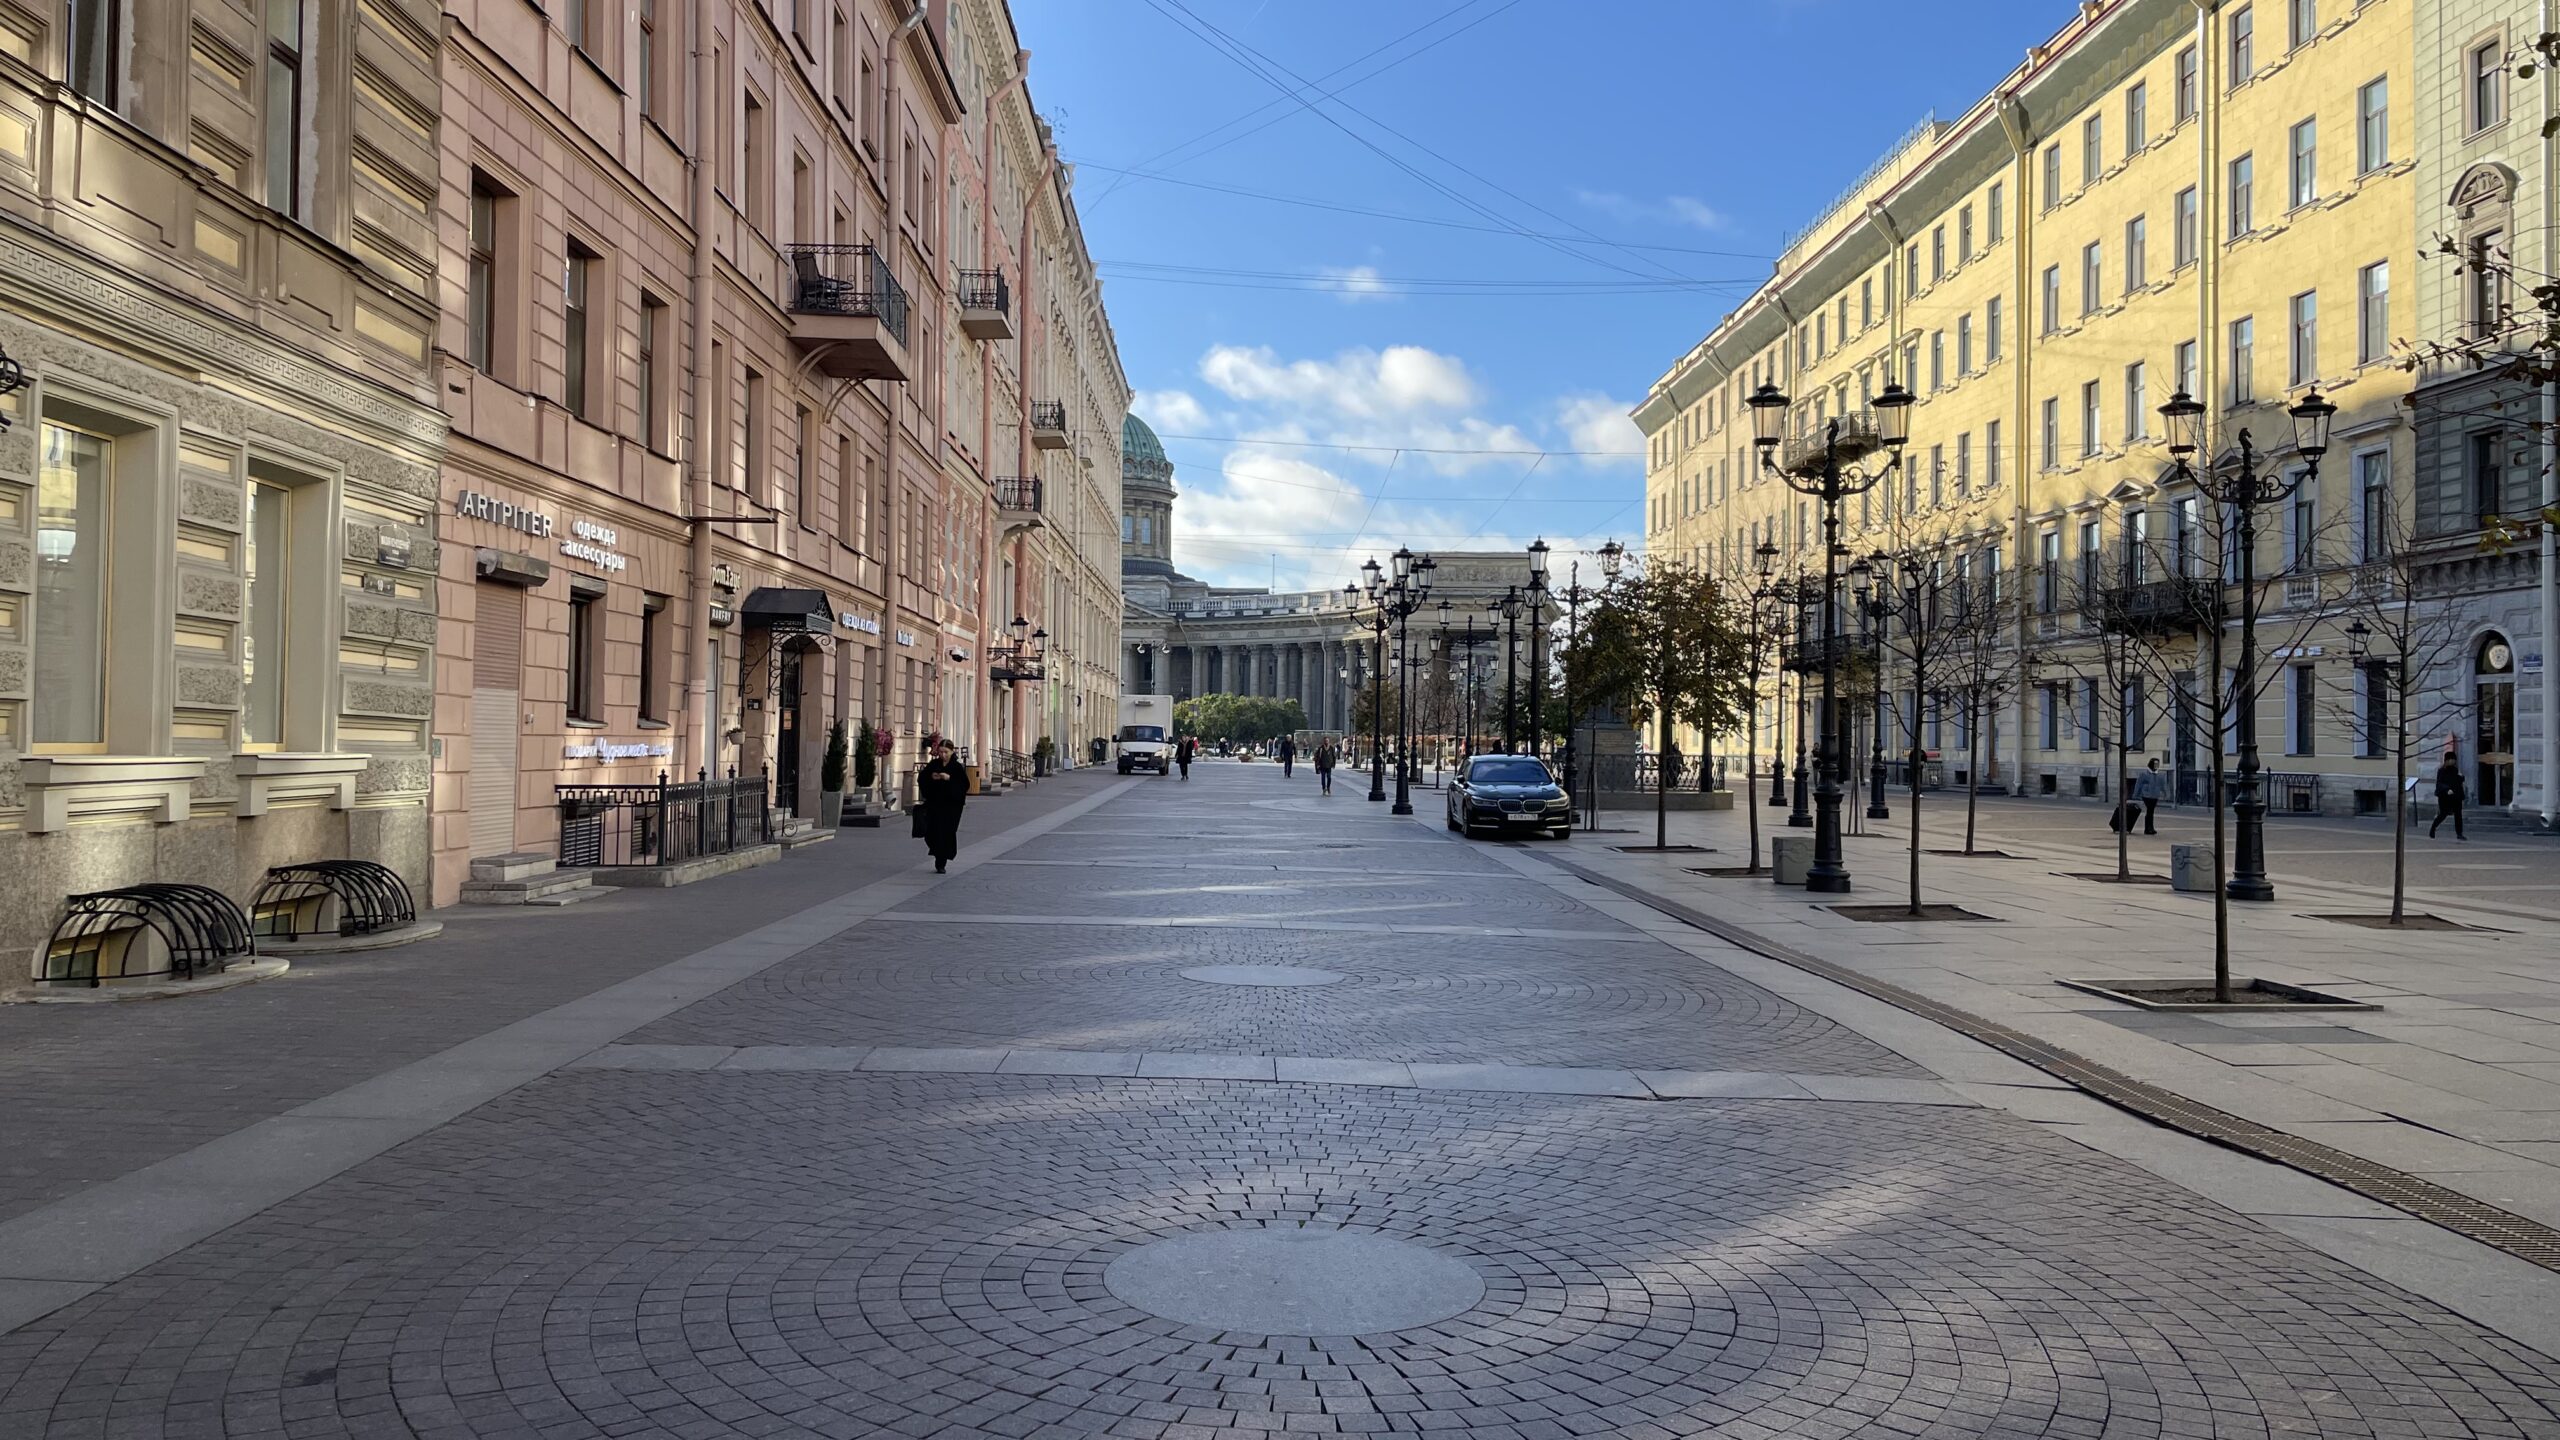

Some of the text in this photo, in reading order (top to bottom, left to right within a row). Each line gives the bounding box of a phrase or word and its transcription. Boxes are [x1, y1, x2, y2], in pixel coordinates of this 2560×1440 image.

[463, 491, 553, 538] ARTPITER
[577, 520, 616, 547] одежда
[566, 539, 625, 572] аксессуары
